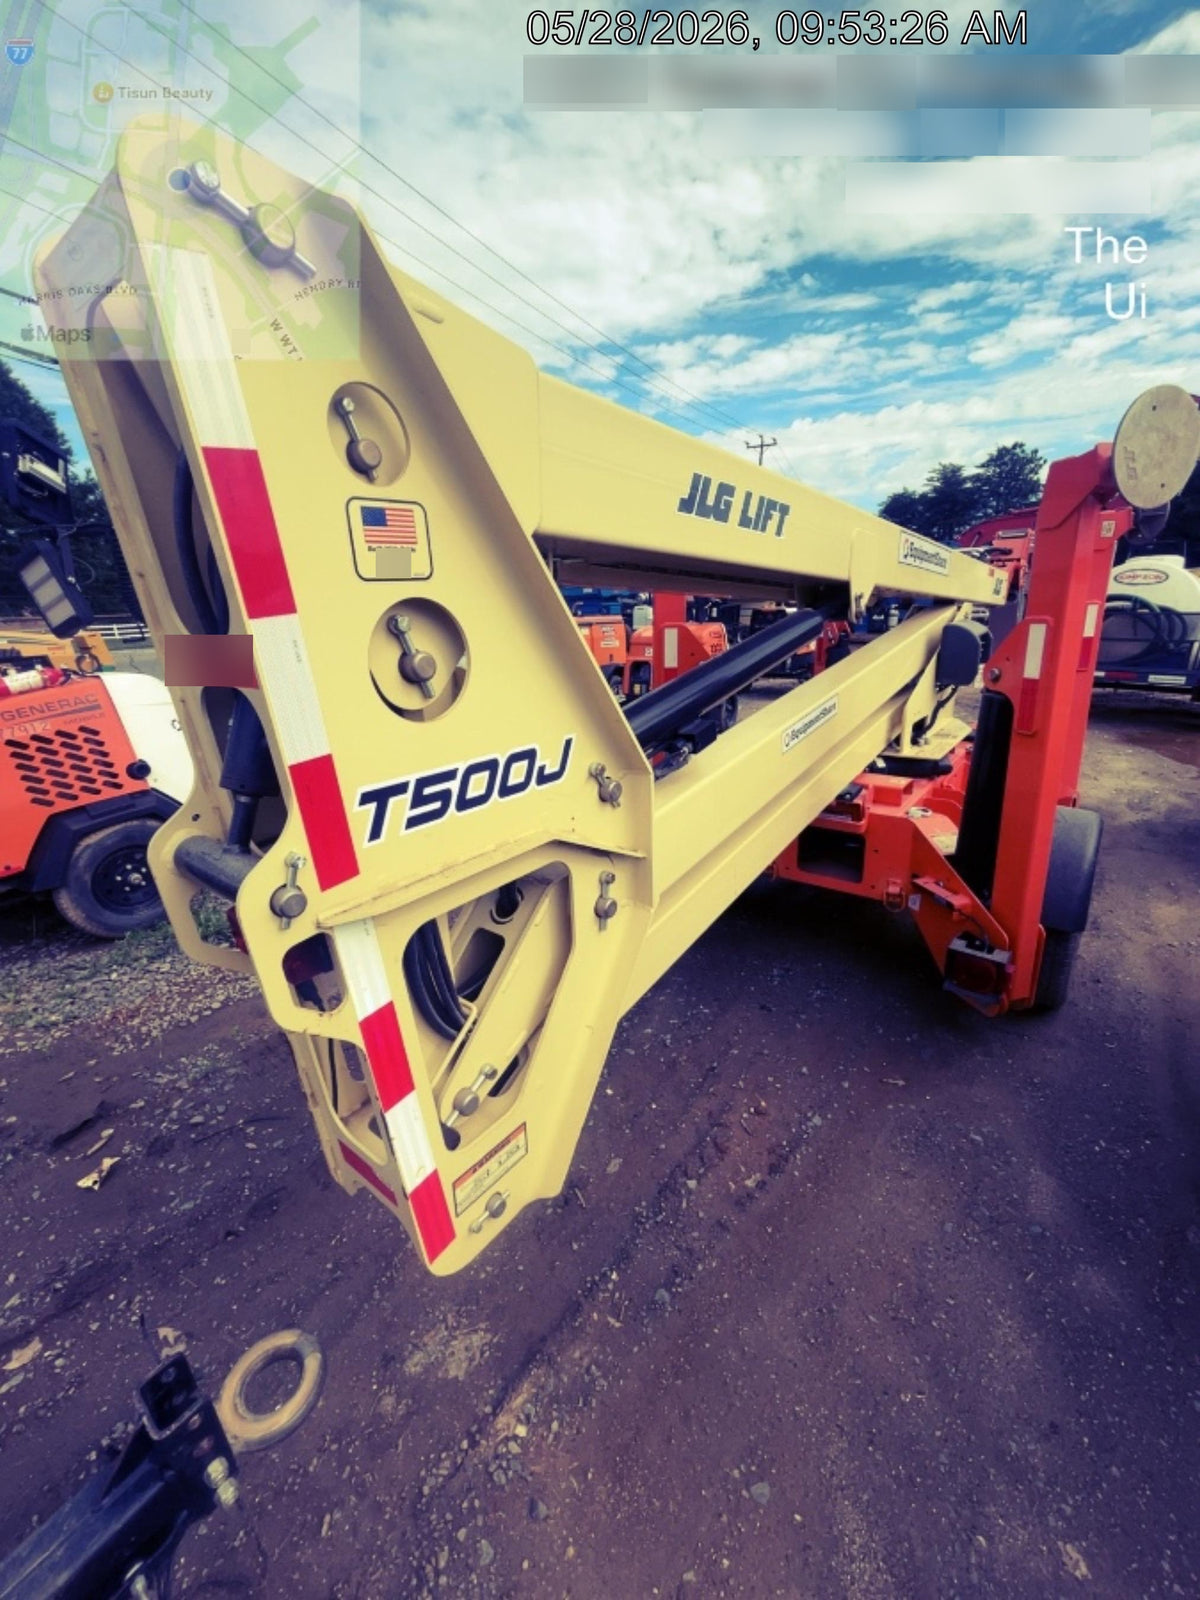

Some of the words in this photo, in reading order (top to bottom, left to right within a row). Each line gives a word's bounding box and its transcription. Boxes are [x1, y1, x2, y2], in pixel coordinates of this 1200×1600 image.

[677, 472, 736, 524] JLG
[738, 490, 790, 538] LIFT
[1, 693, 99, 721] GENERAC
[357, 735, 575, 846] T500J
